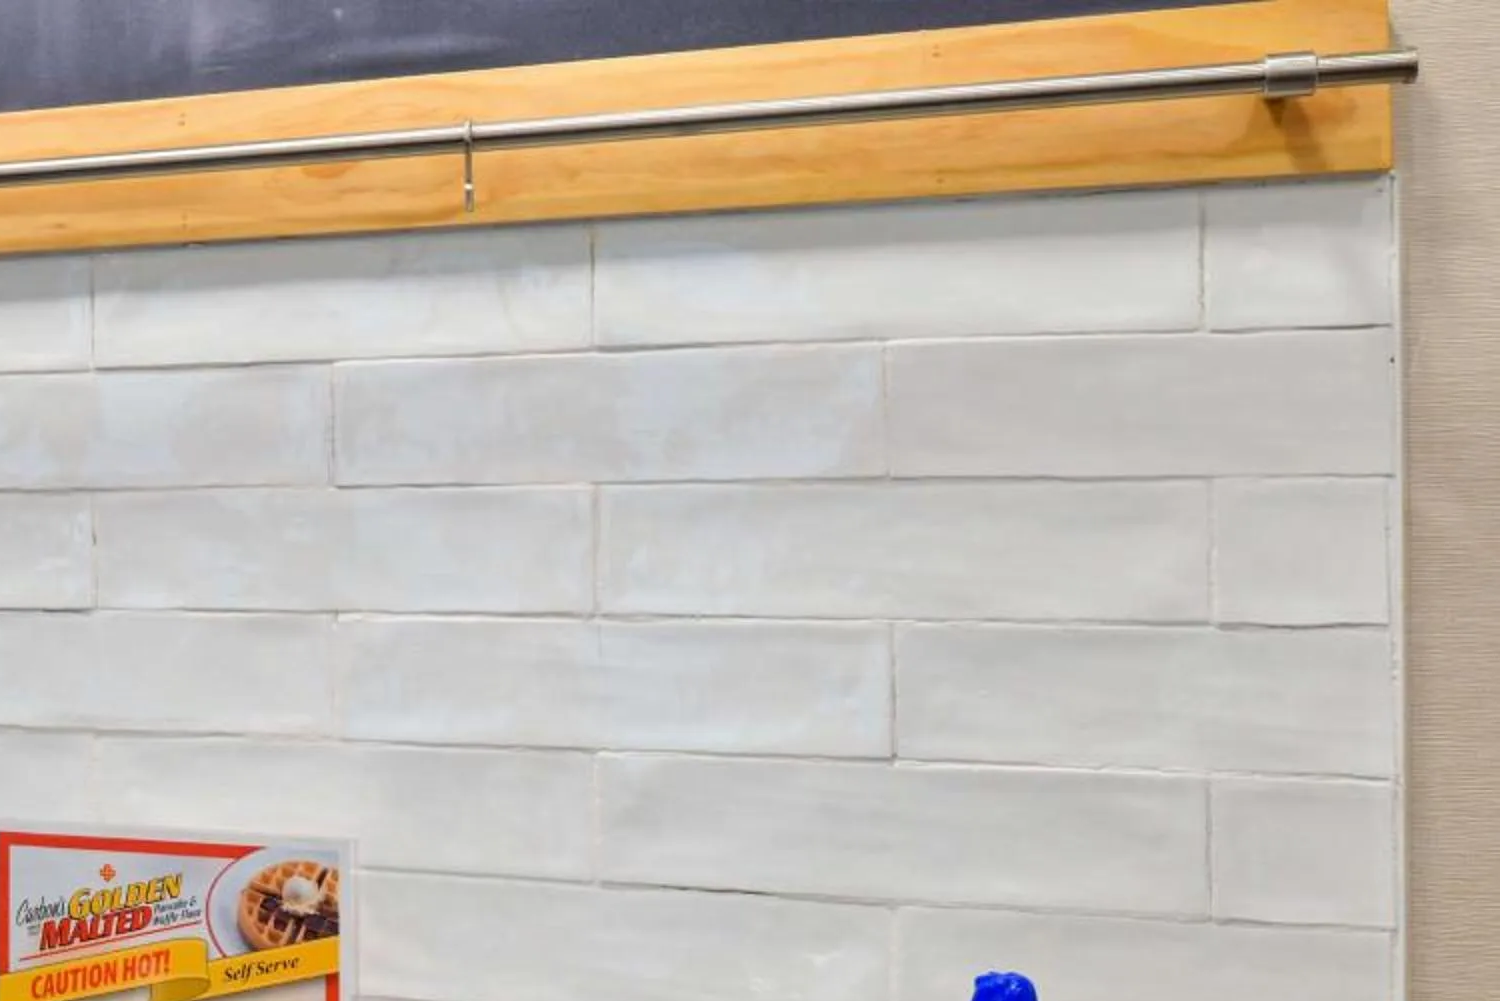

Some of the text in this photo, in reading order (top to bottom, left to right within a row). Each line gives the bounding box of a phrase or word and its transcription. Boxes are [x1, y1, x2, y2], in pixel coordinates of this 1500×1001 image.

[40, 905, 153, 950] MALTED
[31, 948, 171, 1000] CAUTION HOT!
[224, 958, 300, 984] Self Serve
